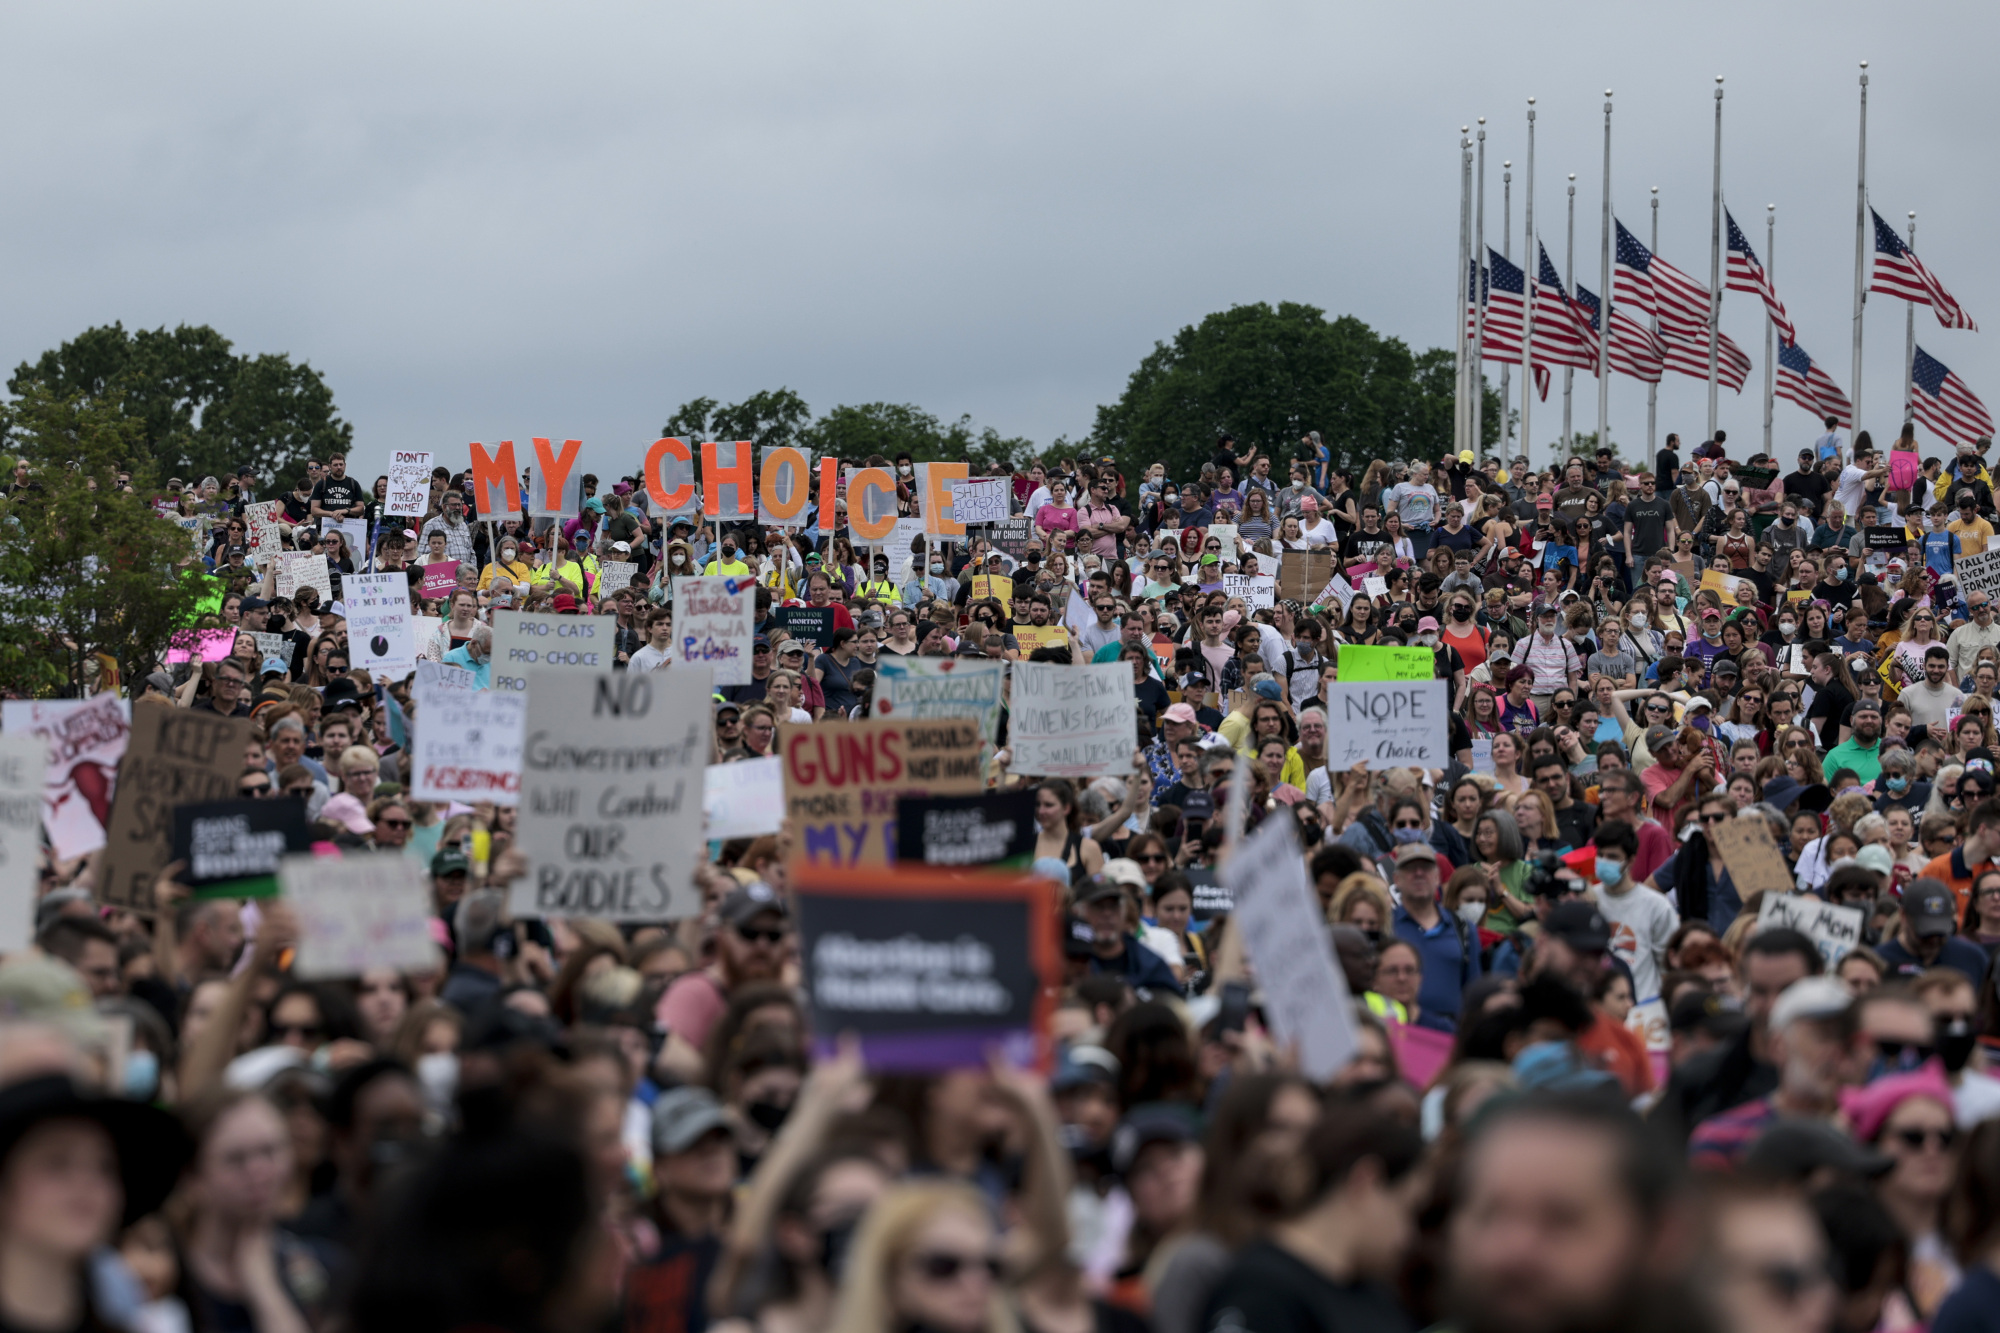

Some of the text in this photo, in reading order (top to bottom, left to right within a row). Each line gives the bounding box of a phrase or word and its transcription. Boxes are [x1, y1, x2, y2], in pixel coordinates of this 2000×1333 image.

[396, 452, 430, 464] DON'T
[327, 486, 351, 495] DETROIT
[469, 436, 969, 542] MY CHOICE
[391, 492, 424, 503] TREAD
[953, 494, 1004, 510] FUCKED &
[955, 506, 1007, 522] BULLSHIT
[1636, 510, 1660, 518] RVCA
[1009, 519, 1029, 529] BODY.
[991, 530, 1028, 540] MY CHOICE.
[1960, 530, 1979, 539] LOVE
[603, 560, 638, 573] PROTECT
[358, 576, 372, 584] AM
[373, 574, 393, 583] THE
[439, 572, 446, 580] is
[602, 574, 632, 583] ABORTIO
[1959, 566, 1985, 582] EVEN
[437, 577, 457, 586] Care.
[1225, 575, 1251, 587] IF MY
[361, 586, 383, 596] BOSS
[1224, 585, 1274, 596] UTERUS SHOT
[363, 597, 378, 607] MY
[381, 596, 406, 607] BODY
[519, 622, 595, 637] PRO-CATS
[1016, 632, 1037, 642] MORE
[509, 648, 600, 666] PRO-CHOICE
[1411, 654, 1432, 662] LAND
[1015, 661, 1051, 697] NOT
[1395, 671, 1431, 679] MY LAND
[593, 672, 653, 720] NO
[1345, 689, 1426, 724] NOPE
[1375, 740, 1430, 761] Choice
[789, 730, 904, 787] GUNS
[564, 822, 632, 864] OUR
[804, 821, 868, 868] MY
[536, 862, 671, 914] BODIES
